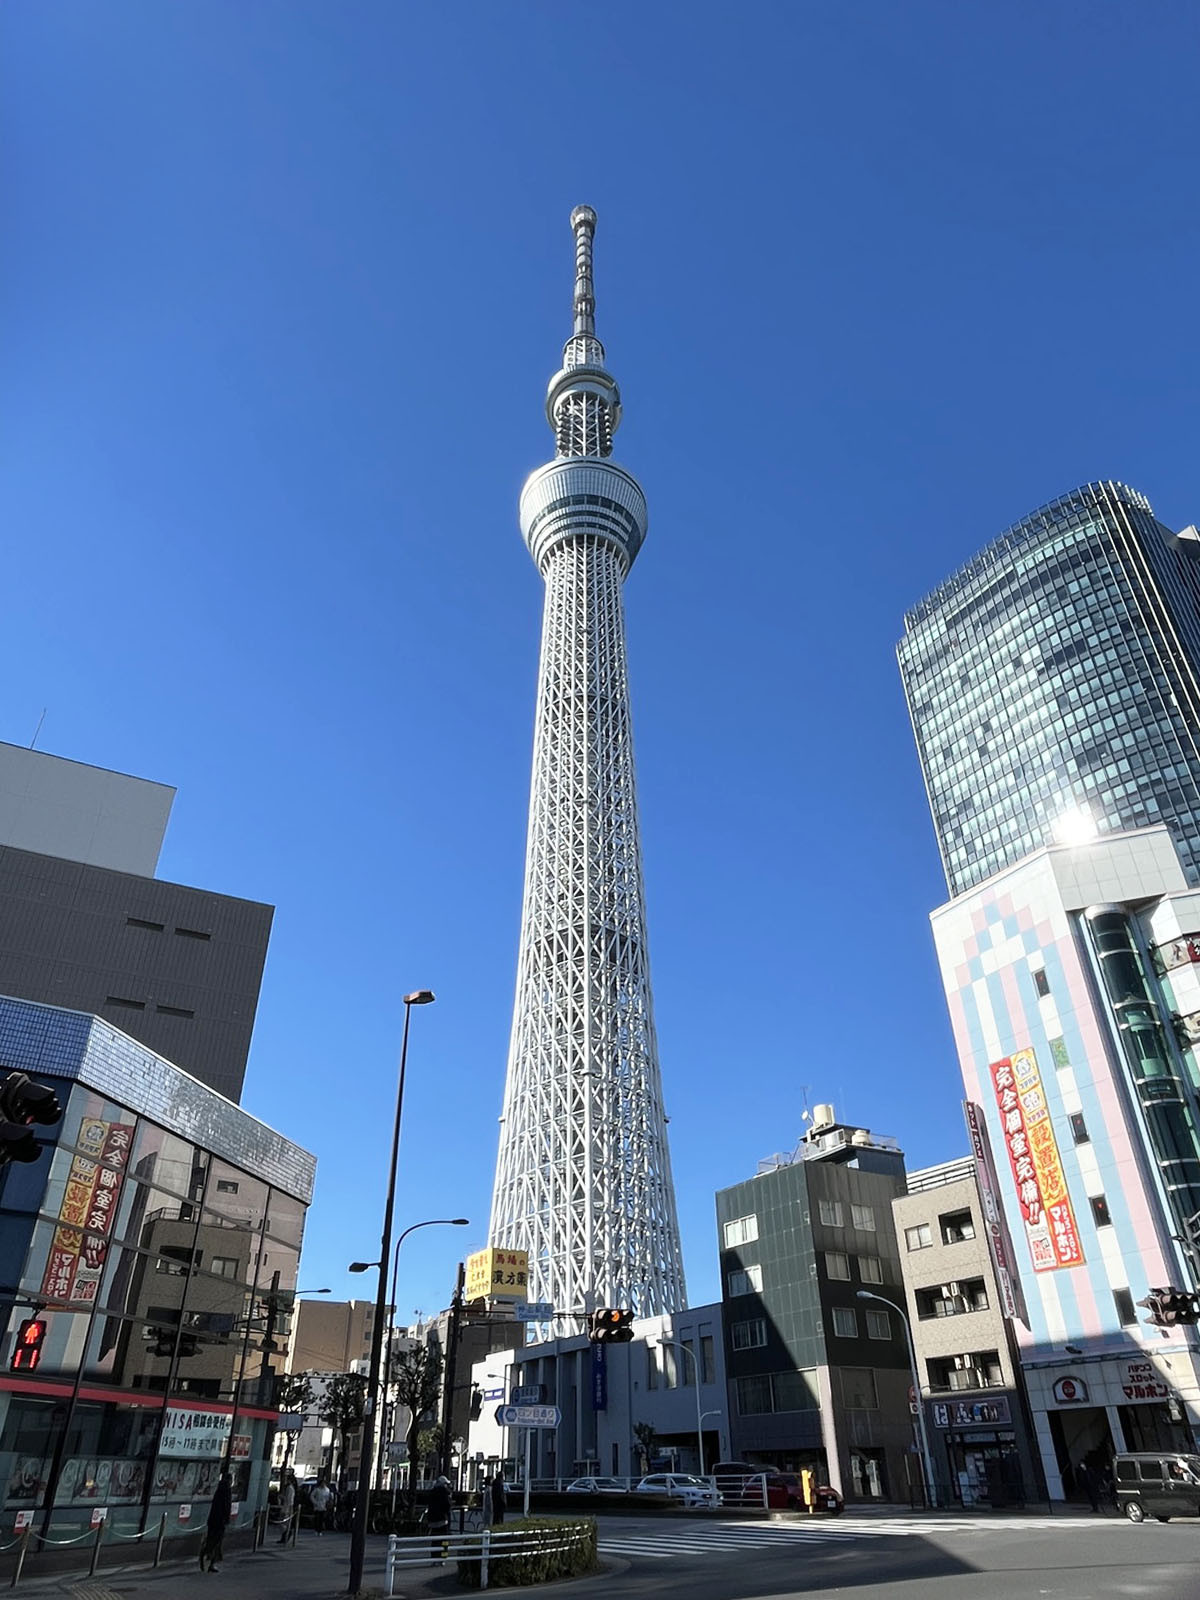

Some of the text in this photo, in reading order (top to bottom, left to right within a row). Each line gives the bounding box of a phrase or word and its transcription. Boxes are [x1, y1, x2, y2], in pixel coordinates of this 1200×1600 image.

[1049, 1206, 1073, 1262] マルホン
[492, 1270, 527, 1286] 漢方薬
[1128, 1363, 1152, 1373] パチンコ
[1130, 1373, 1155, 1383] スロット
[1123, 1383, 1169, 1400] マルホン
